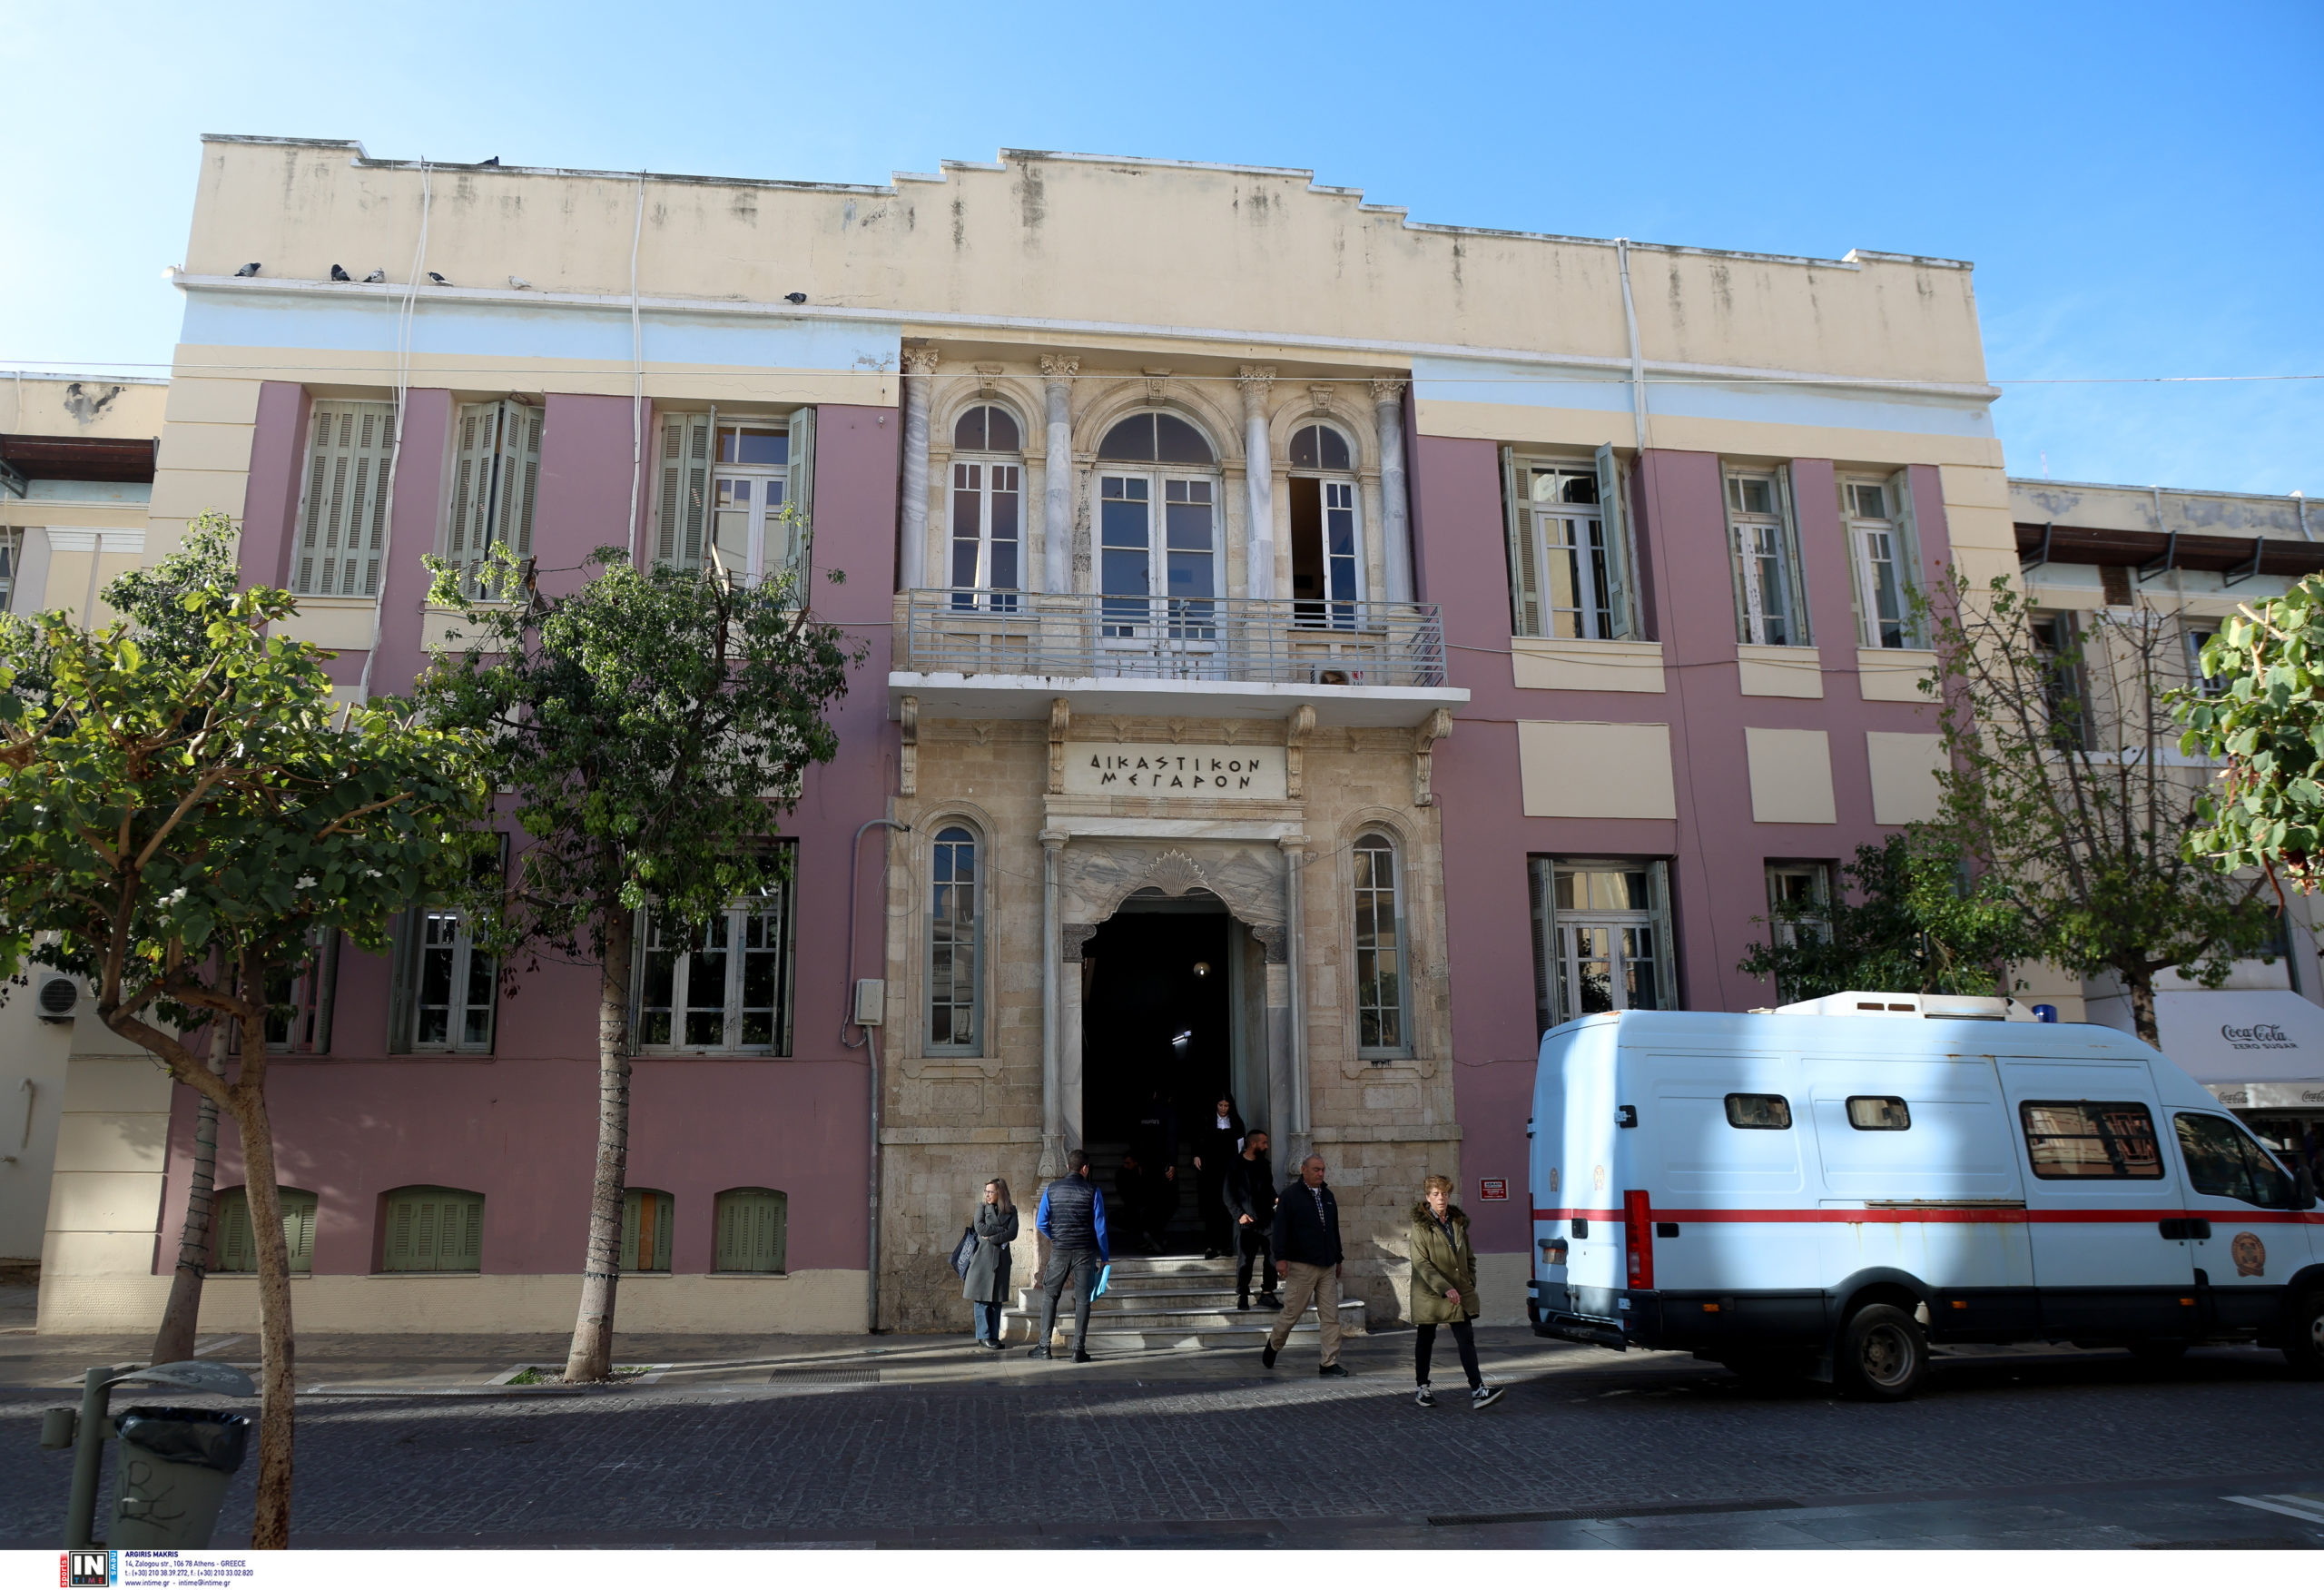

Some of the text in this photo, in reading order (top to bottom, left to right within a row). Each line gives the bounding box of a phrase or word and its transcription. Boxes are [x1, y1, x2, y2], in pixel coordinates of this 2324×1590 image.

[1101, 772, 1250, 789] ΜΕΓΑΡΟΝ
[2221, 1024, 2290, 1042] Coca-Cola
[1482, 1389, 1489, 1397] N
